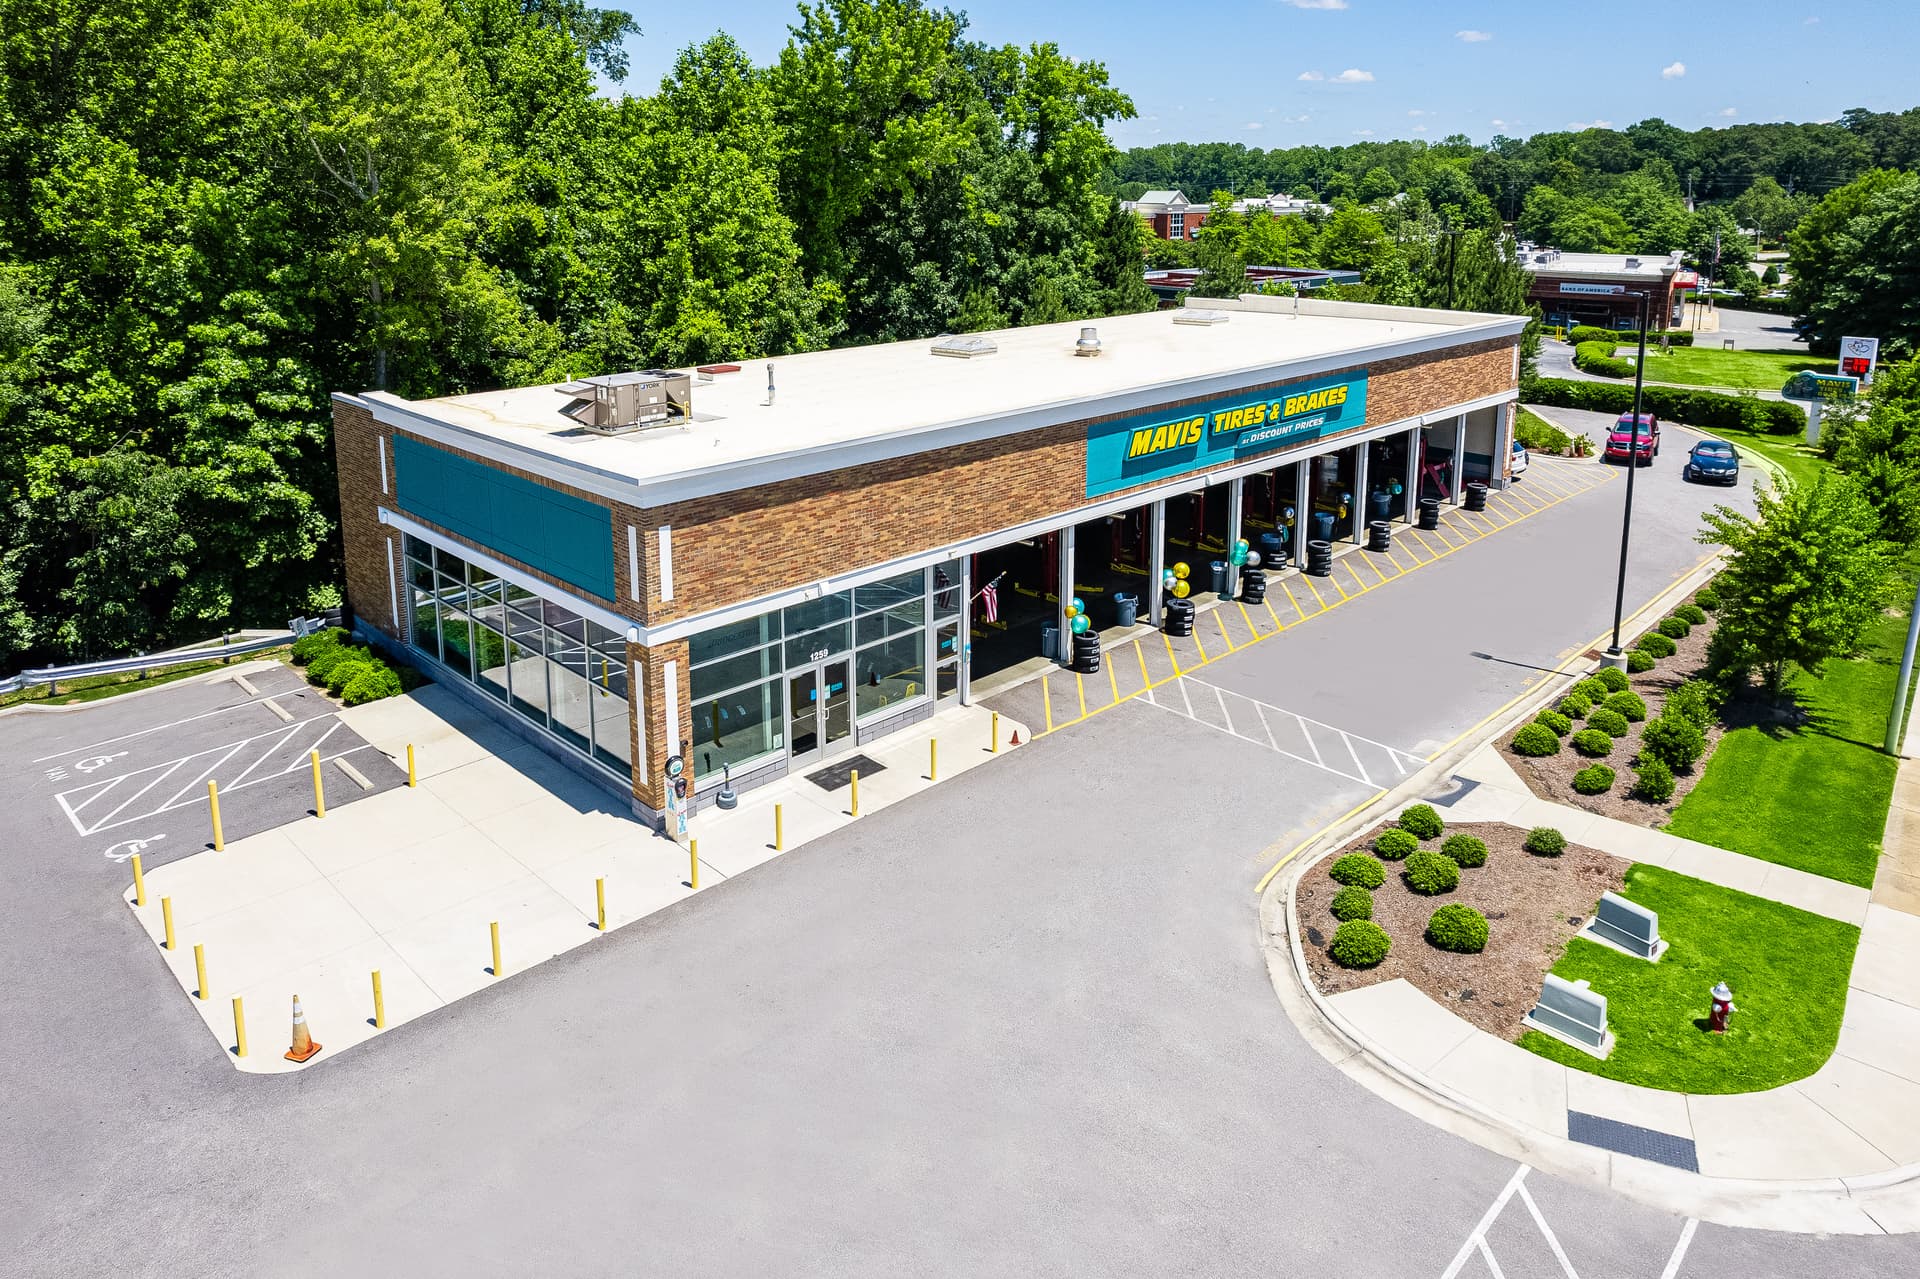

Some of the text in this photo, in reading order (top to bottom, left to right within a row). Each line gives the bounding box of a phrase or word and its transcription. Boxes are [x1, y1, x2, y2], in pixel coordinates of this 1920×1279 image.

[1816, 379, 1851, 388] MAVIS
[1129, 386, 1349, 458] MAVIS TIRES & BRAKES
[1250, 425, 1294, 443] DISCOUNT
[1294, 417, 1325, 432] PRICES
[809, 648, 829, 662] 1259
[43, 766, 71, 782] VAN
